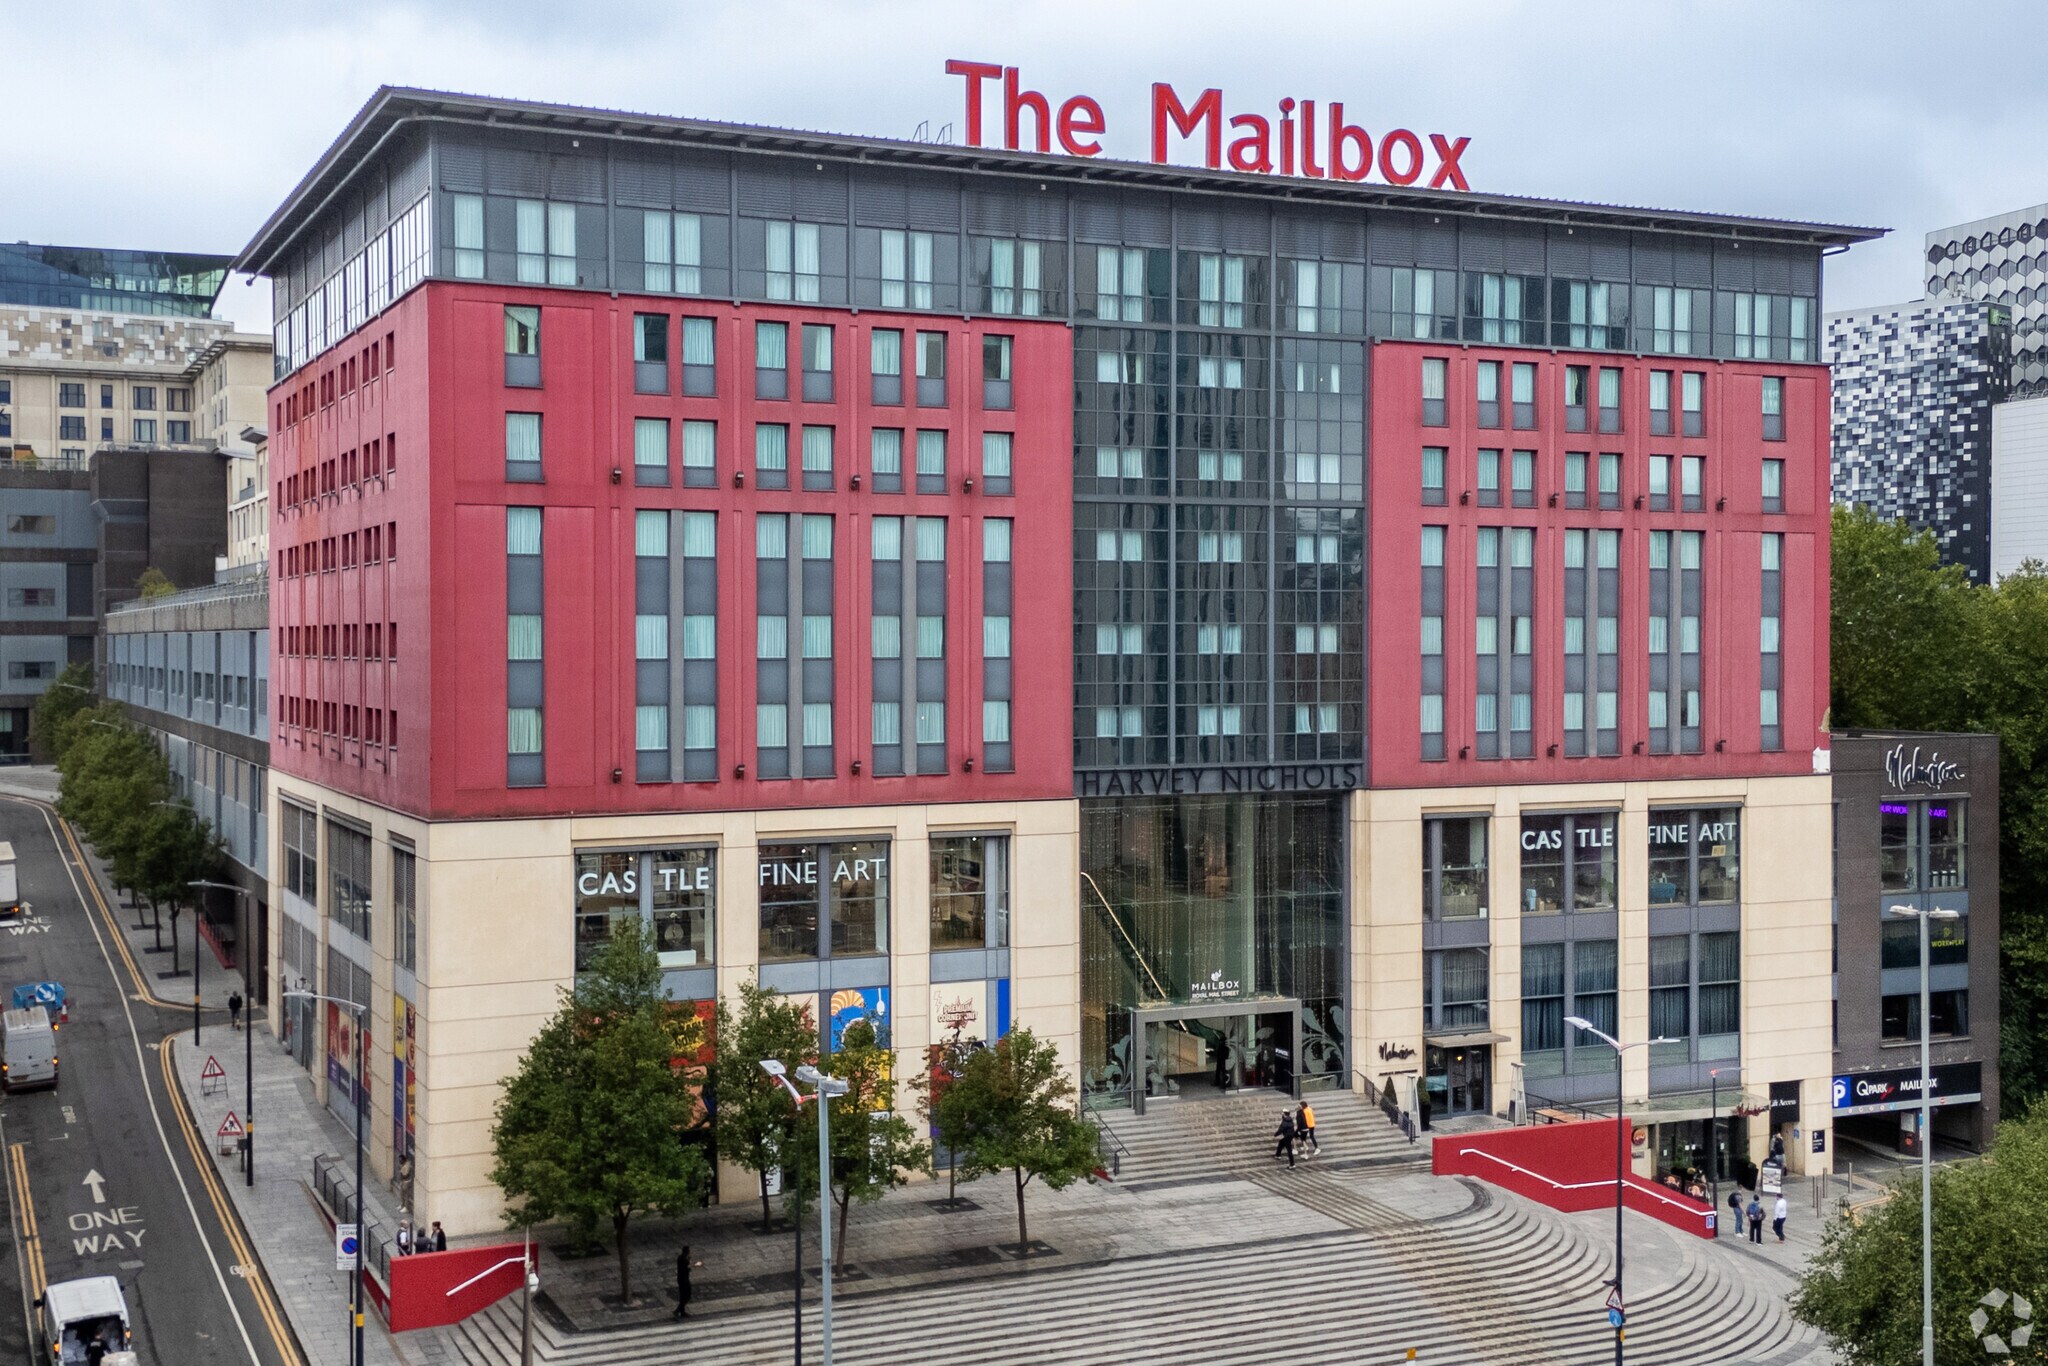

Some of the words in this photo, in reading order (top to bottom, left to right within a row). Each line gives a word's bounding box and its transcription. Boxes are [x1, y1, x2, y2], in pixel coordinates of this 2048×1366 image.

[945, 59, 1106, 158] The
[1151, 82, 1472, 191] Mailbox
[1081, 768, 1205, 796] HARVEY
[1221, 763, 1358, 792] NICHOLS
[1521, 827, 1613, 850] CASTLE
[1648, 824, 1689, 844] FINE
[1698, 822, 1737, 841] ART
[578, 867, 709, 895] CASTLE
[760, 861, 817, 886] FINE
[833, 858, 886, 882] ART
[8, 925, 52, 935] WAY
[22, 916, 52, 925] NE
[1191, 980, 1239, 991] MAILBOX
[69, 1206, 144, 1231] ONE
[73, 1229, 146, 1255] WAY
